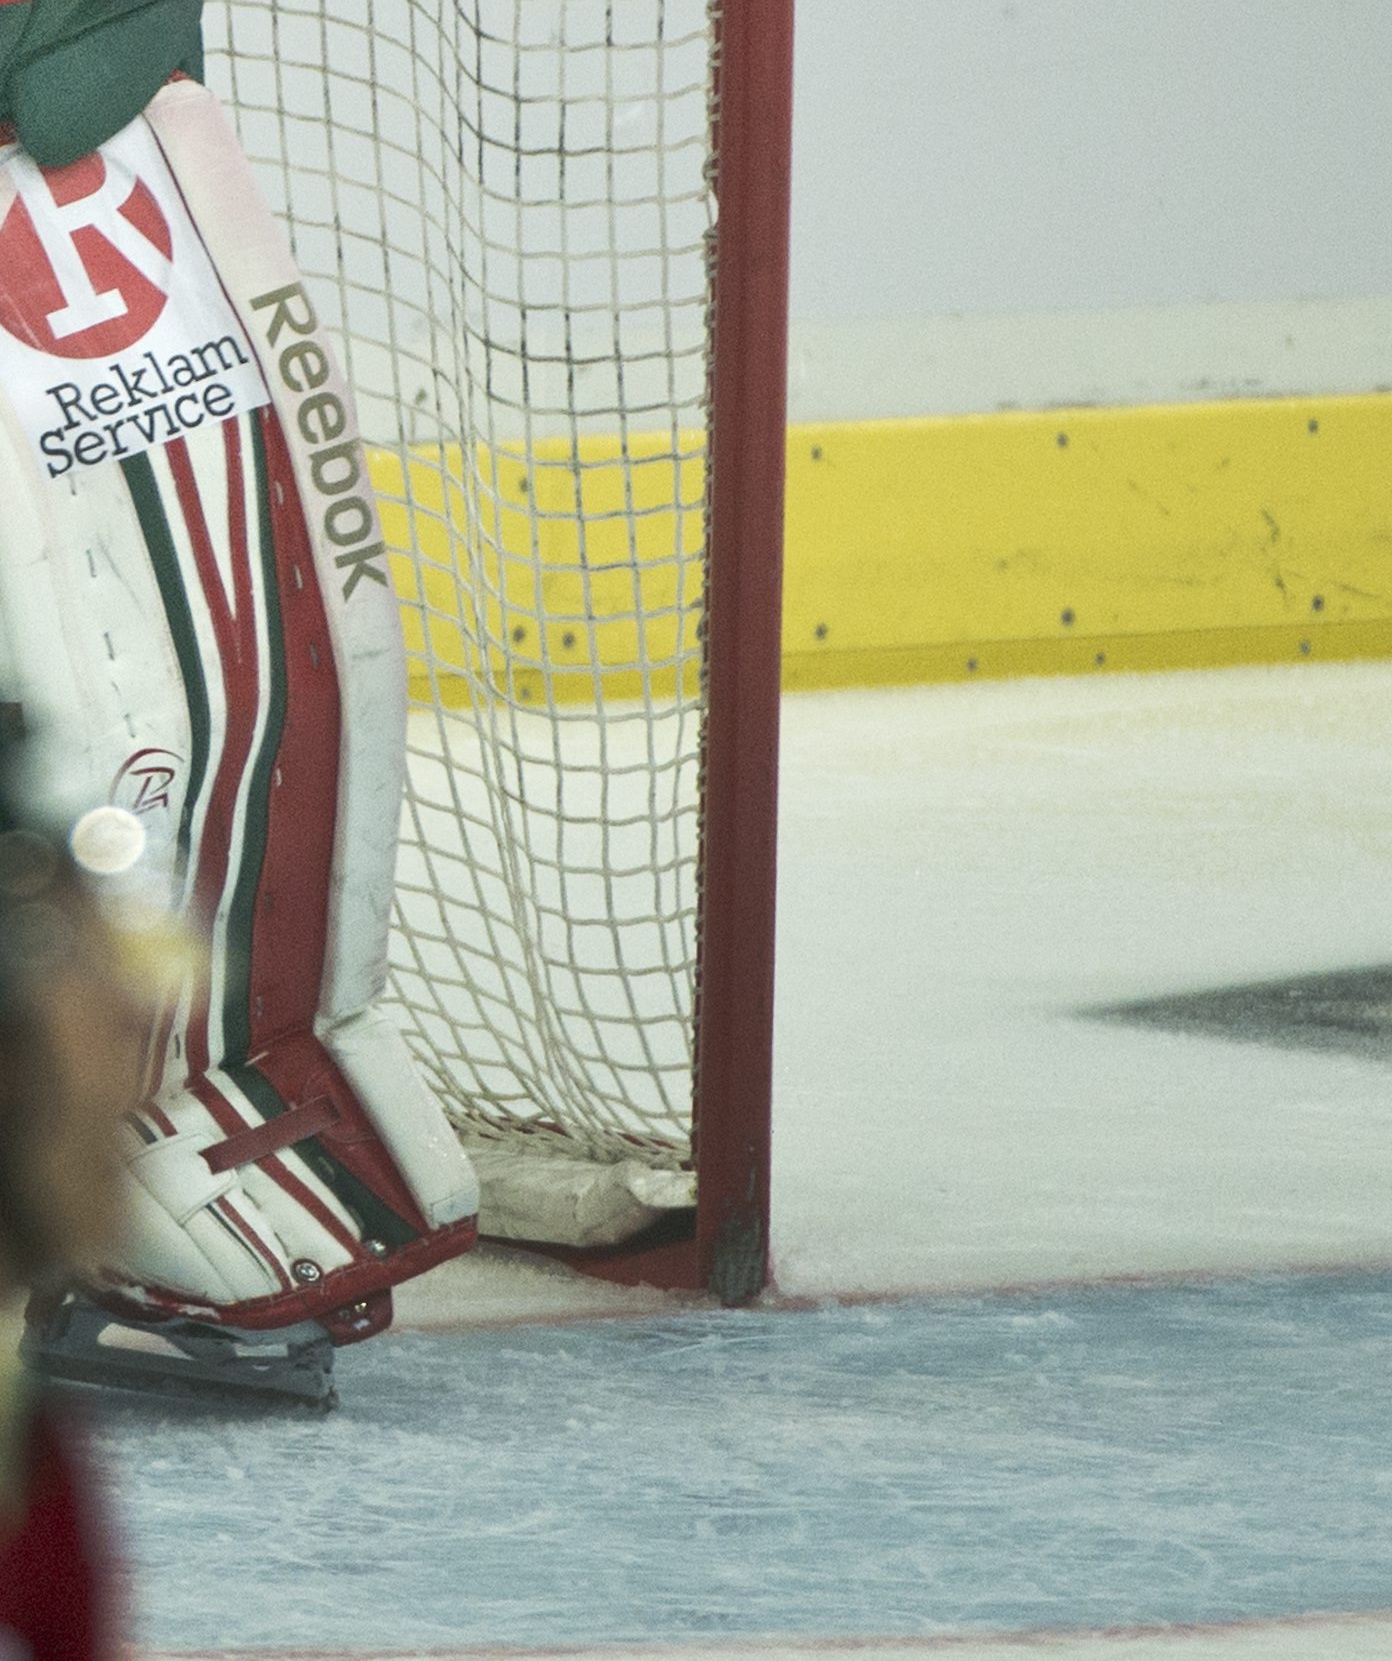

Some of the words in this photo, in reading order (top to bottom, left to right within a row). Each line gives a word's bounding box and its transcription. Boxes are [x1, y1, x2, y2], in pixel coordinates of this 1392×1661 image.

[39, 382, 235, 479] Service
[45, 334, 249, 431] Reklam
[248, 280, 389, 604] Reebok
